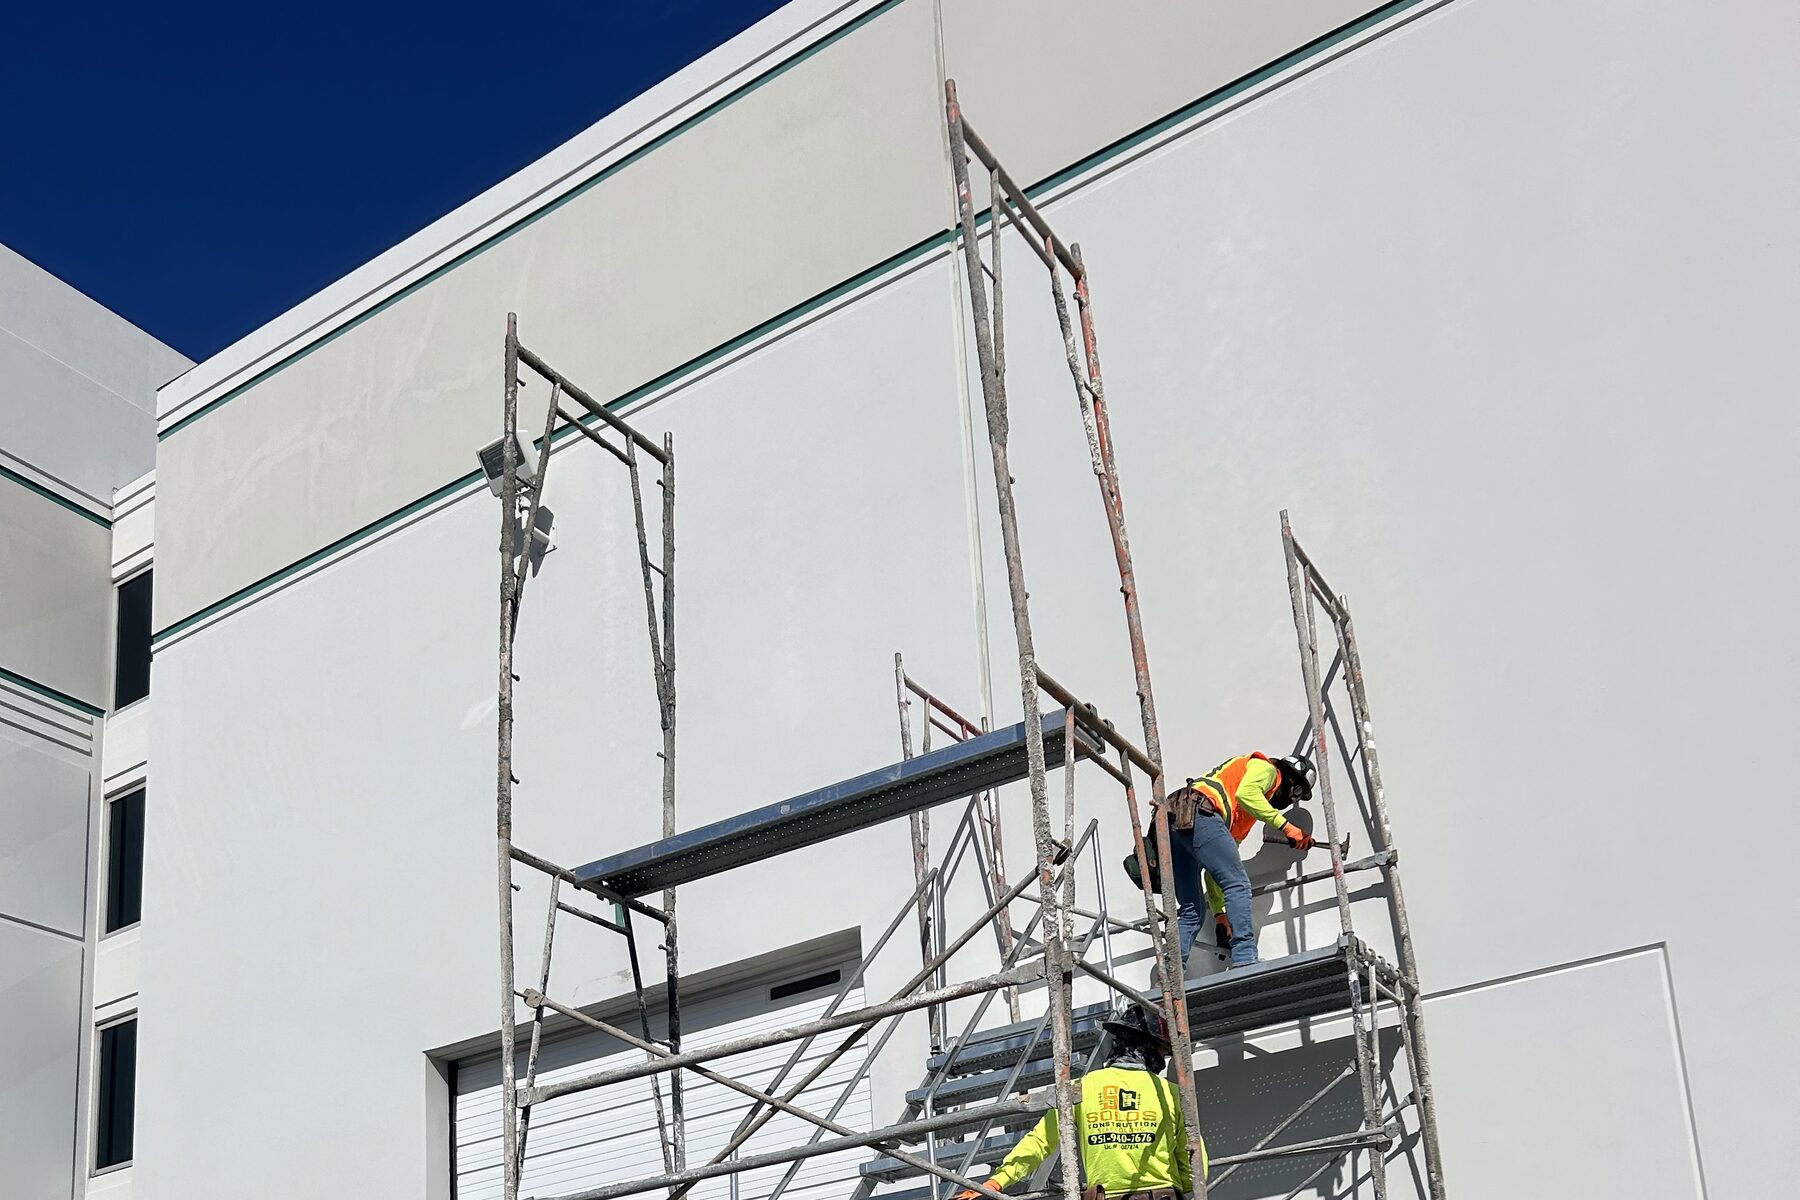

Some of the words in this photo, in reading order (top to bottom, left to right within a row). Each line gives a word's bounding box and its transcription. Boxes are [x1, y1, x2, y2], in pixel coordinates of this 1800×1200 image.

[1086, 1110, 1157, 1123] SOLOS
[1088, 1121, 1157, 1129] CONSTRUCTION
[1090, 1133, 1152, 1144] 951-940-7676
